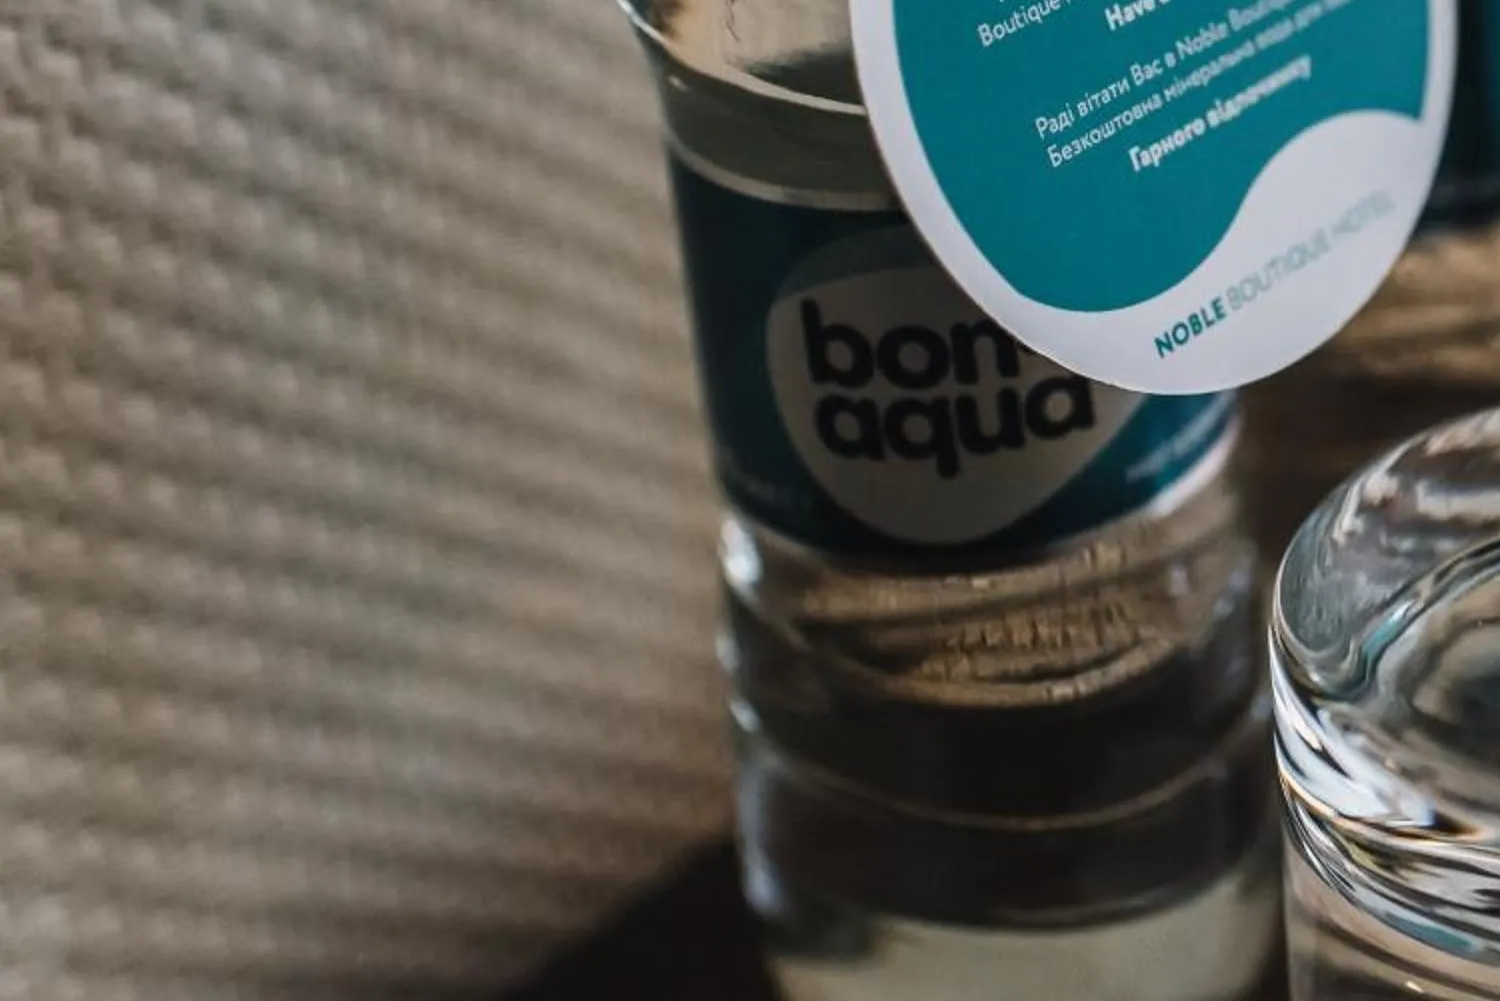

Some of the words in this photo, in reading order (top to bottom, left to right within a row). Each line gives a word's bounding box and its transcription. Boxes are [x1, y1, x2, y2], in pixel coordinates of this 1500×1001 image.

[1035, 103, 1075, 139] Раді
[1076, 76, 1130, 117] вітати
[1129, 58, 1163, 86] Вас
[1175, 21, 1228, 60] Noble
[1047, 93, 1163, 168] Безкоштовна
[1129, 116, 1206, 172] Гарного
[1154, 296, 1228, 359] NOBLE
[1226, 227, 1330, 313] BOUTIQUE
[801, 298, 1020, 389] bon
[813, 374, 1096, 478] aqua
